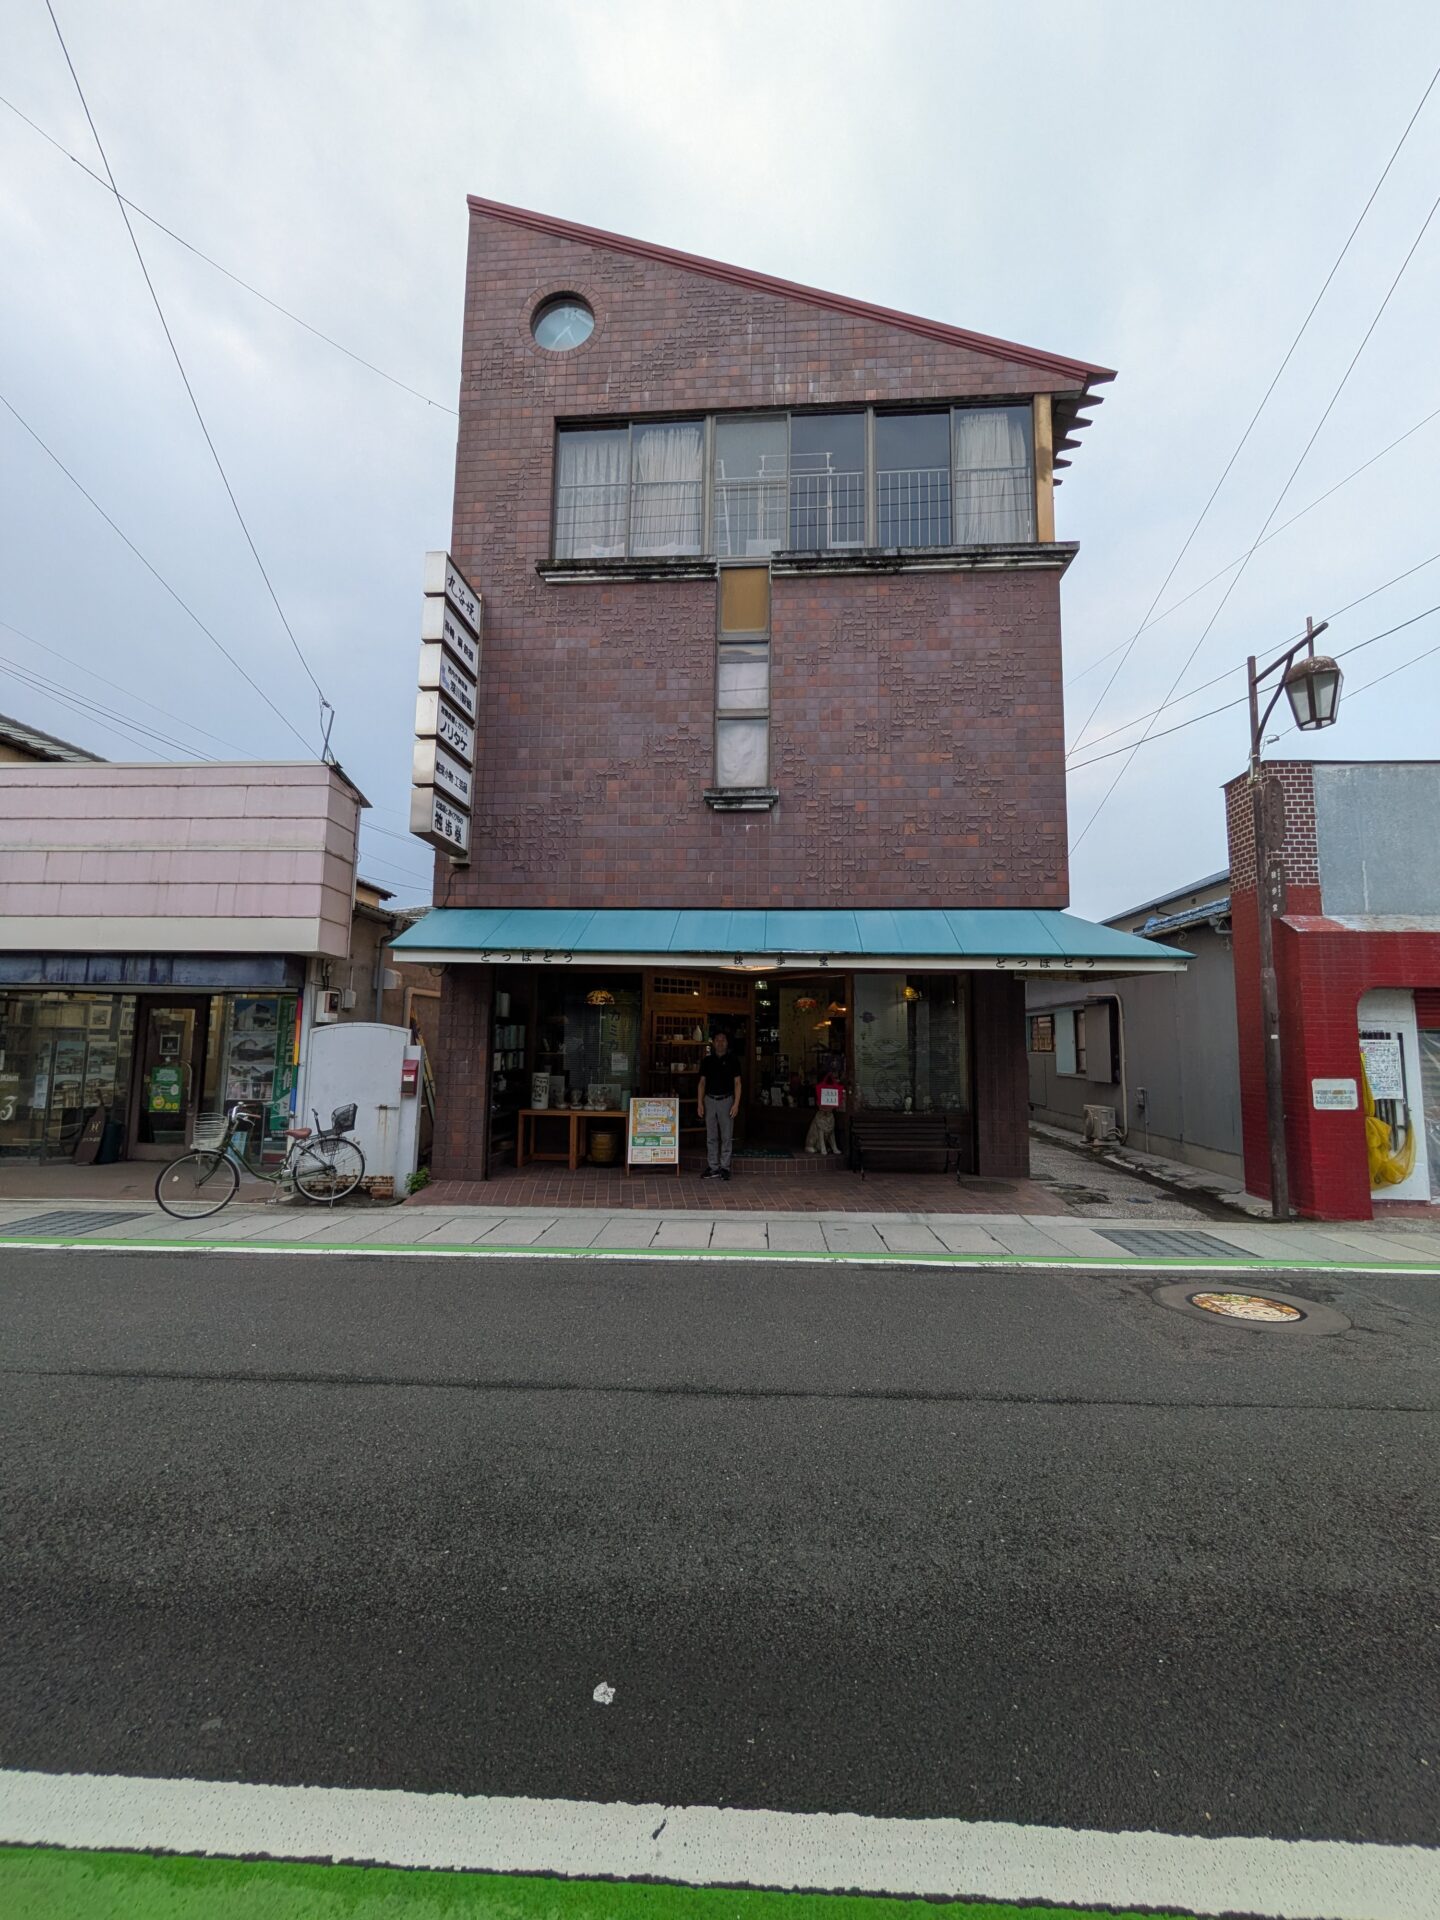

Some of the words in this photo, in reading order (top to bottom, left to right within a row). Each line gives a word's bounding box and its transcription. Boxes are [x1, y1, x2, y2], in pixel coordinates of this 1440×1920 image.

[440, 721, 468, 752] ノリタケ
[480, 951, 574, 963] どっぽどう
[995, 956, 1096, 968] どっぽどう
